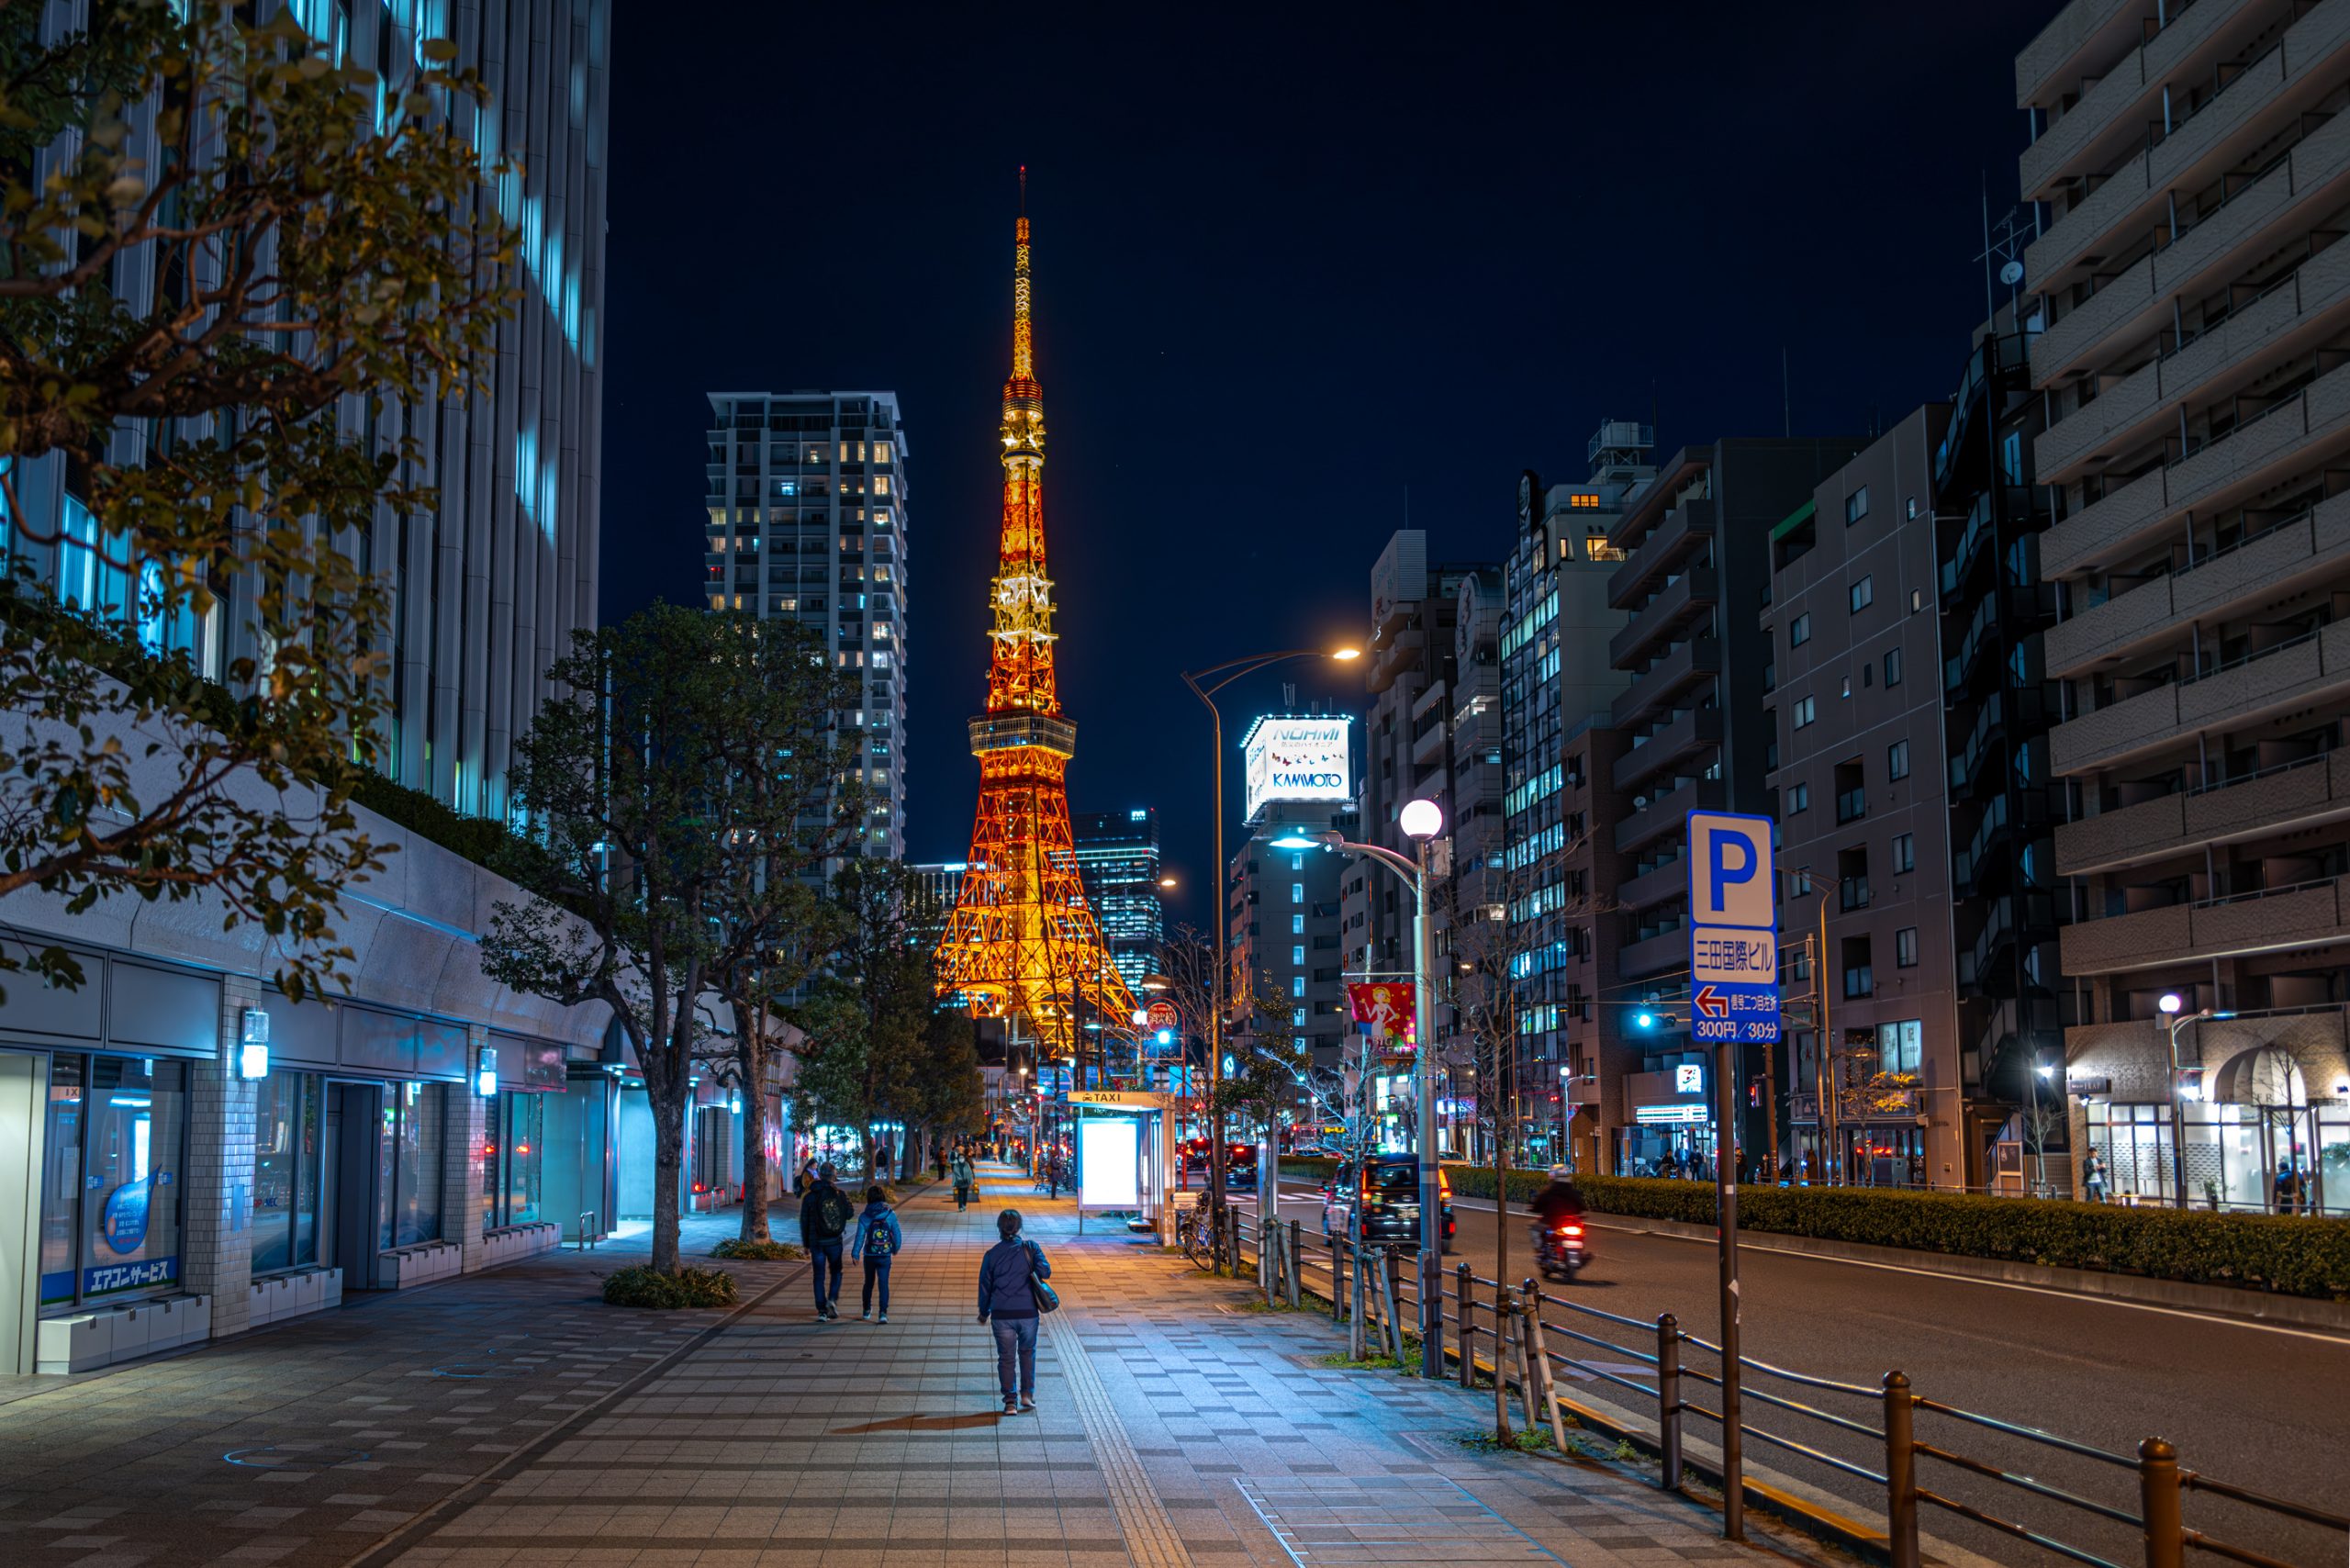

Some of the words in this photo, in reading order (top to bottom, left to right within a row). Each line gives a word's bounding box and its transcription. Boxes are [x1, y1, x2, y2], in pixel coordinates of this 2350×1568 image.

[1708, 828, 1757, 912] P
[1696, 940, 1774, 971] 三田国際ビル
[1731, 994, 1777, 1012] 信号二つ目左折
[1093, 1093, 1121, 1103] TAXI
[90, 1260, 169, 1293] エアコンサービス
